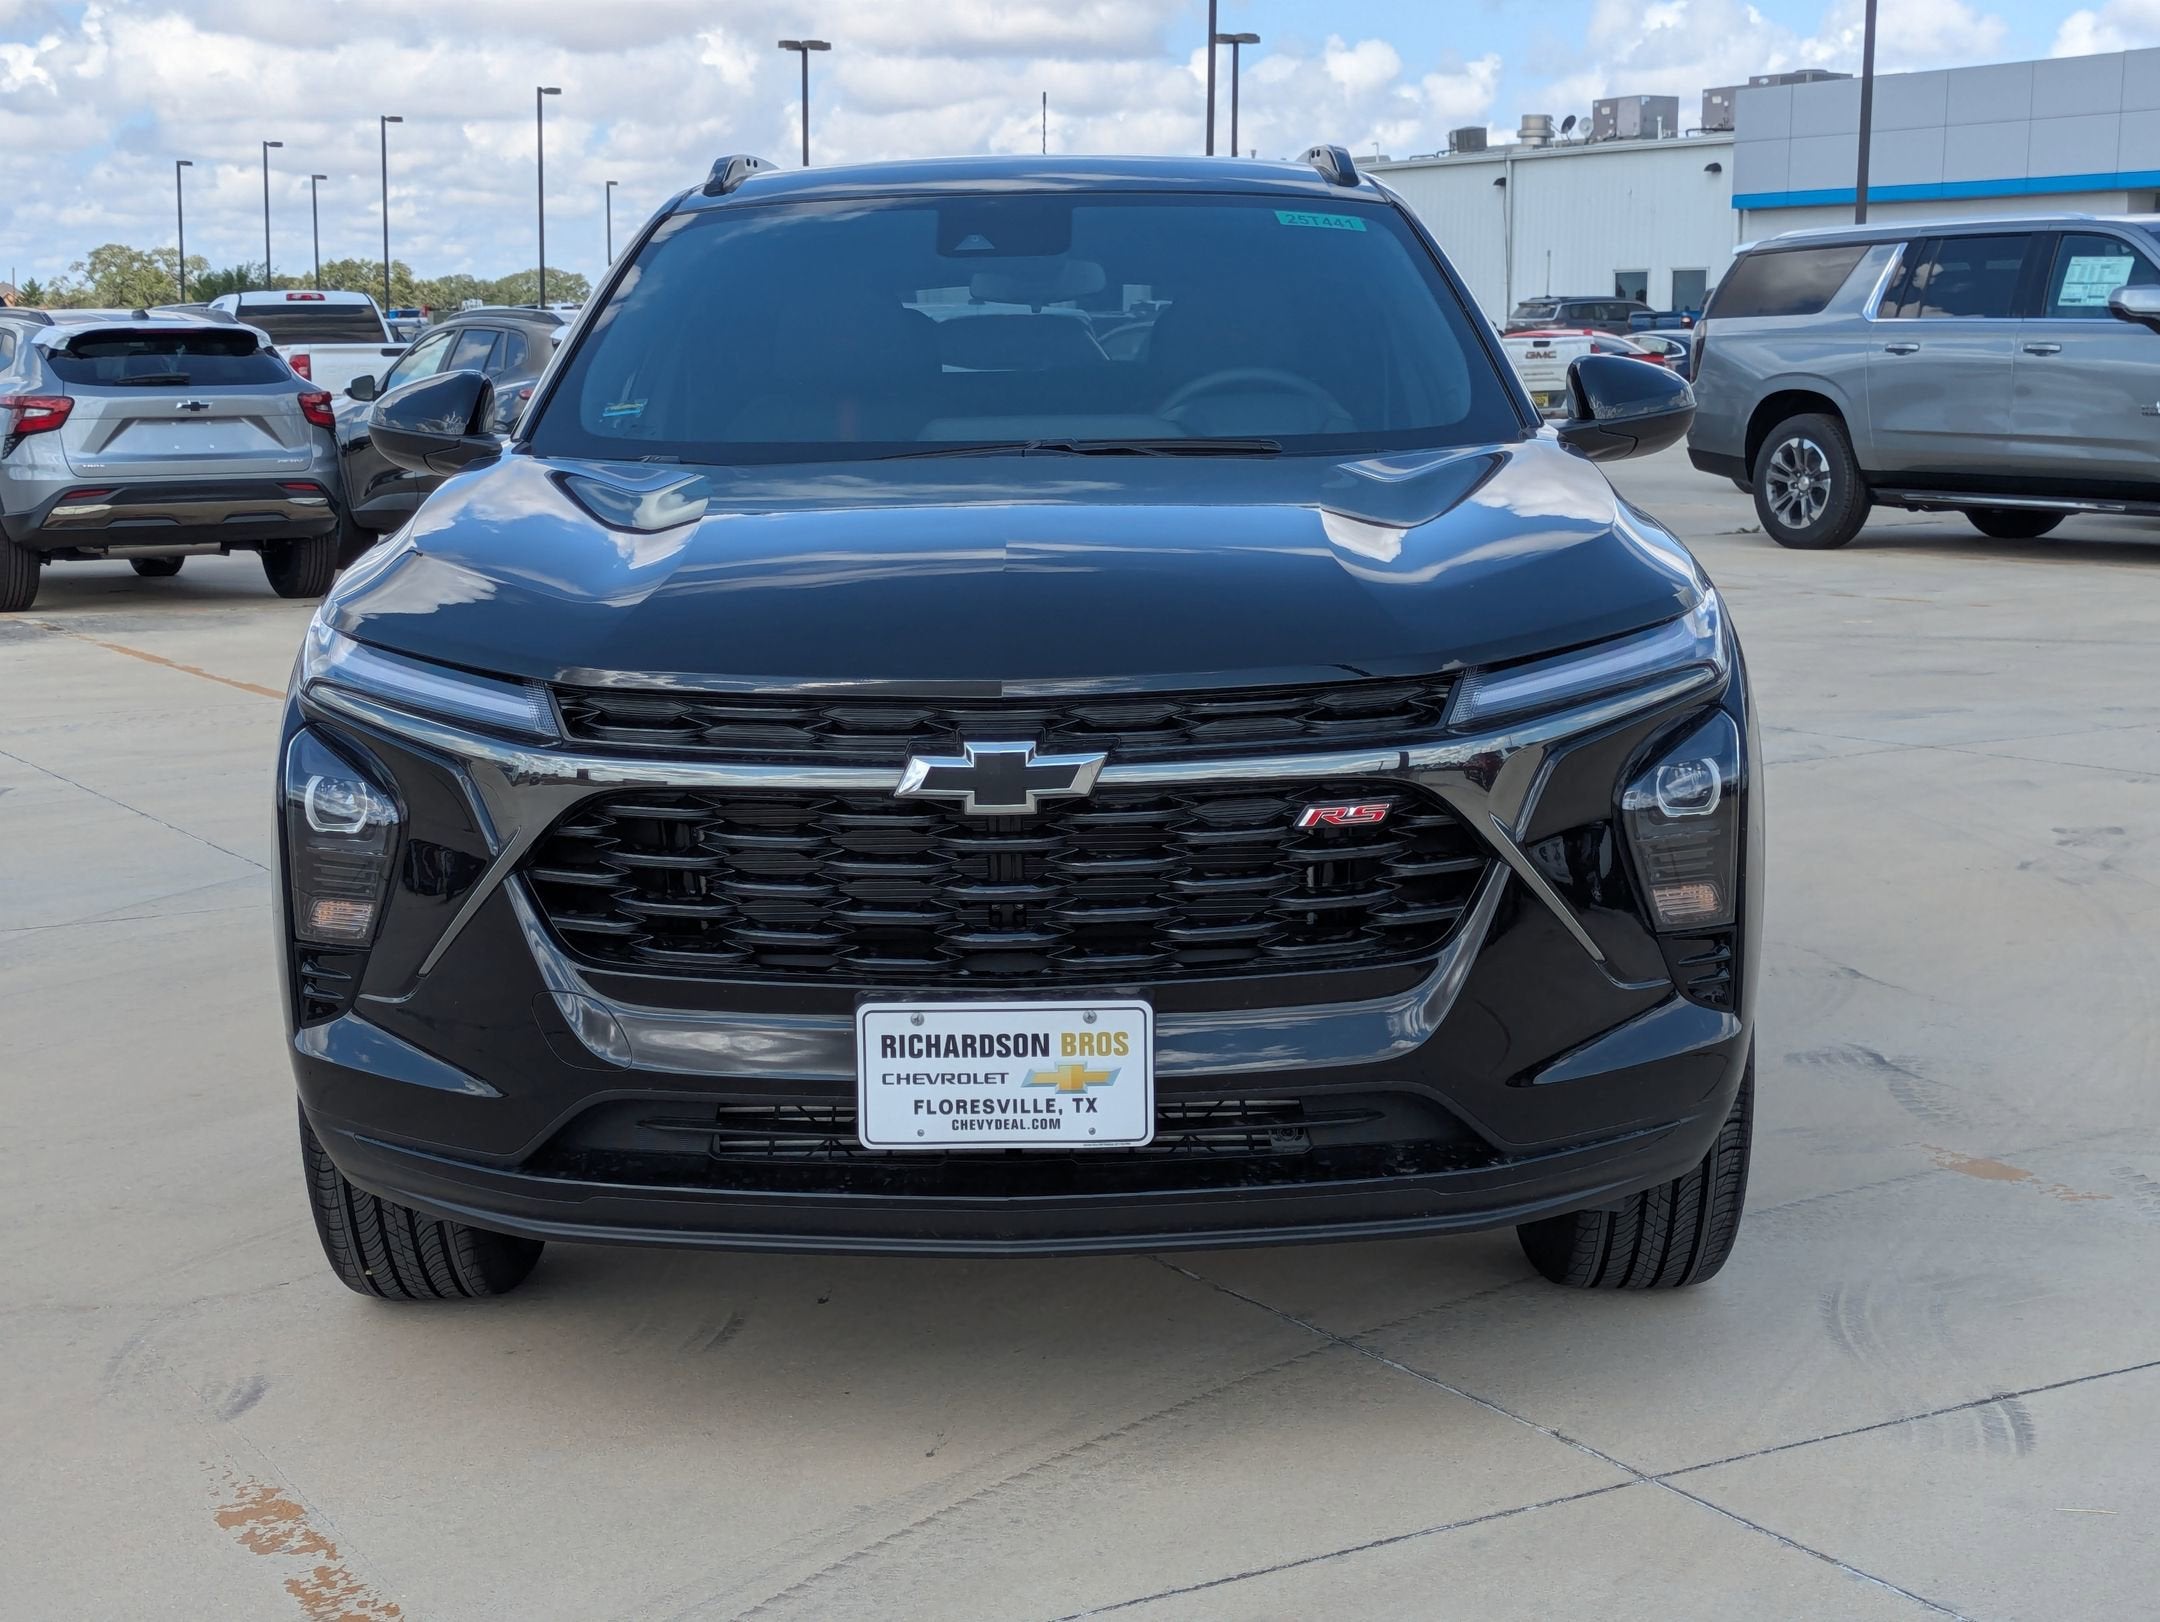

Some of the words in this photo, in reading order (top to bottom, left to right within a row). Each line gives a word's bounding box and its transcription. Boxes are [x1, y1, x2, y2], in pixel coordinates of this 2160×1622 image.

[1285, 214, 1355, 229] 25T441
[1525, 351, 1557, 360] GMC
[1297, 803, 1390, 827] RS
[880, 1033, 1049, 1059] RICHARDSON
[1060, 1031, 1129, 1057] BROS
[881, 1072, 1009, 1085] CHEVROLET
[913, 1098, 1063, 1115] FLORESVILLE,
[1072, 1097, 1098, 1114] TX
[951, 1118, 1061, 1131] CHEVYDEAL.COM
